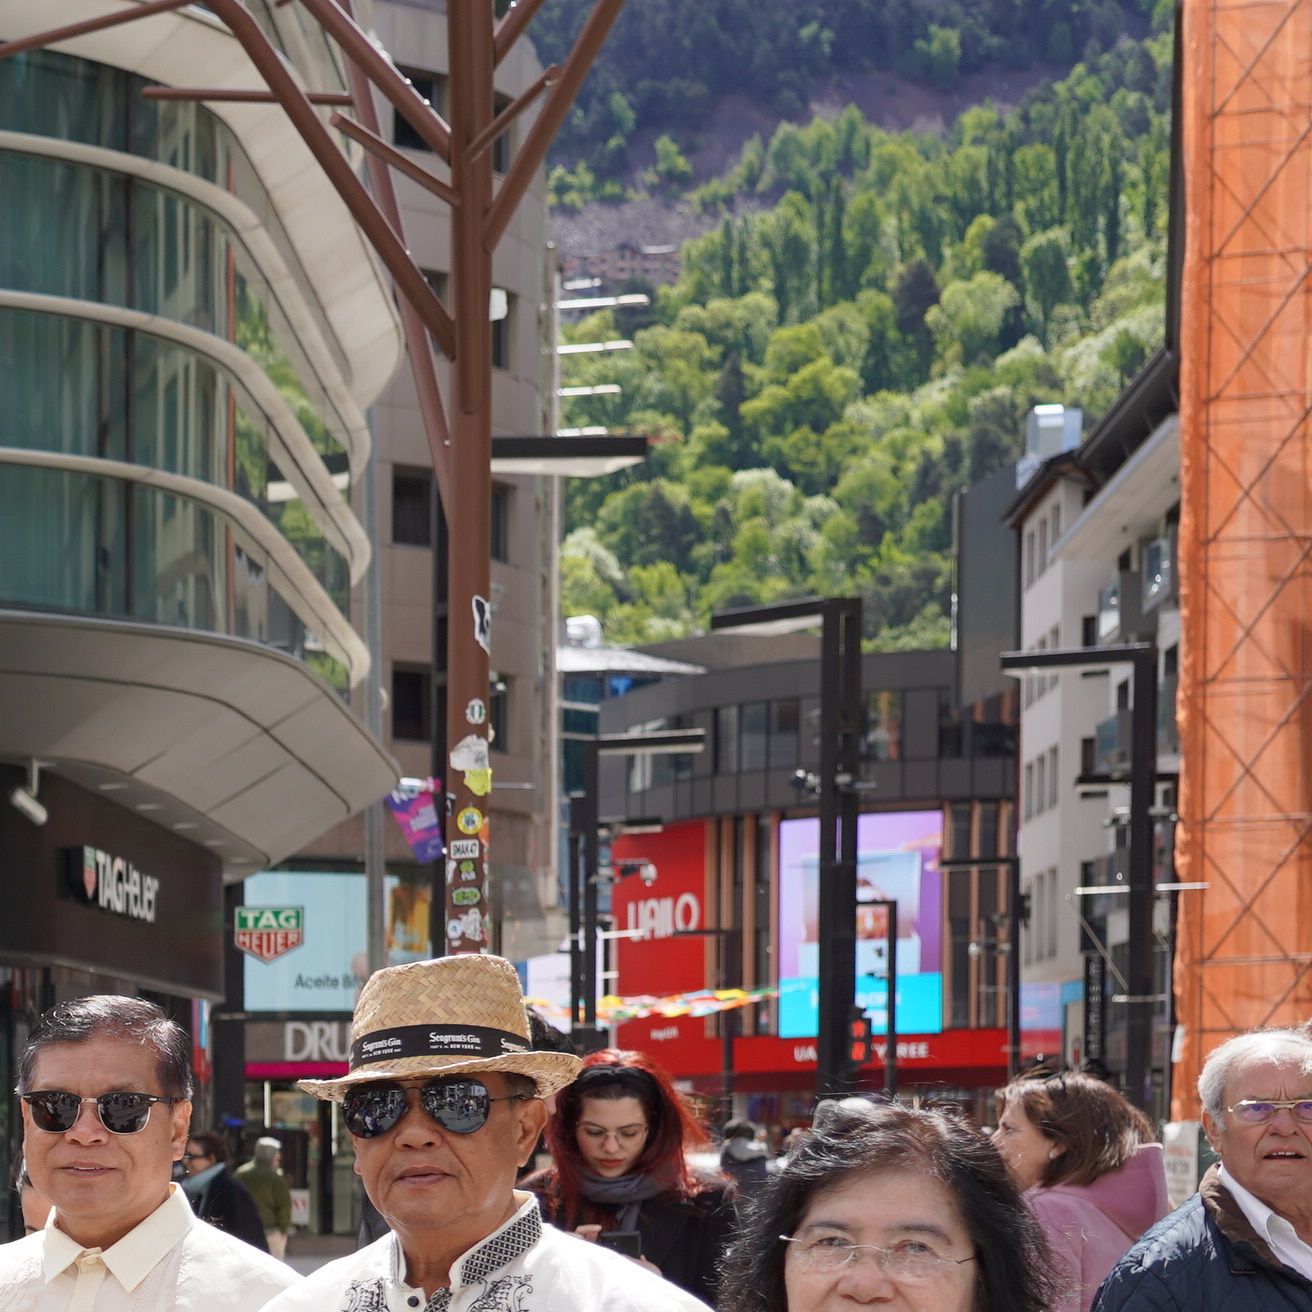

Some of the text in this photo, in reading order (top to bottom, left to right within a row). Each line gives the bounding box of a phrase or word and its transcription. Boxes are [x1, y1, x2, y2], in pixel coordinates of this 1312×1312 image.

[241, 909, 298, 929] TAG
[238, 930, 300, 955] HEUER
[294, 973, 339, 990] Aceite
